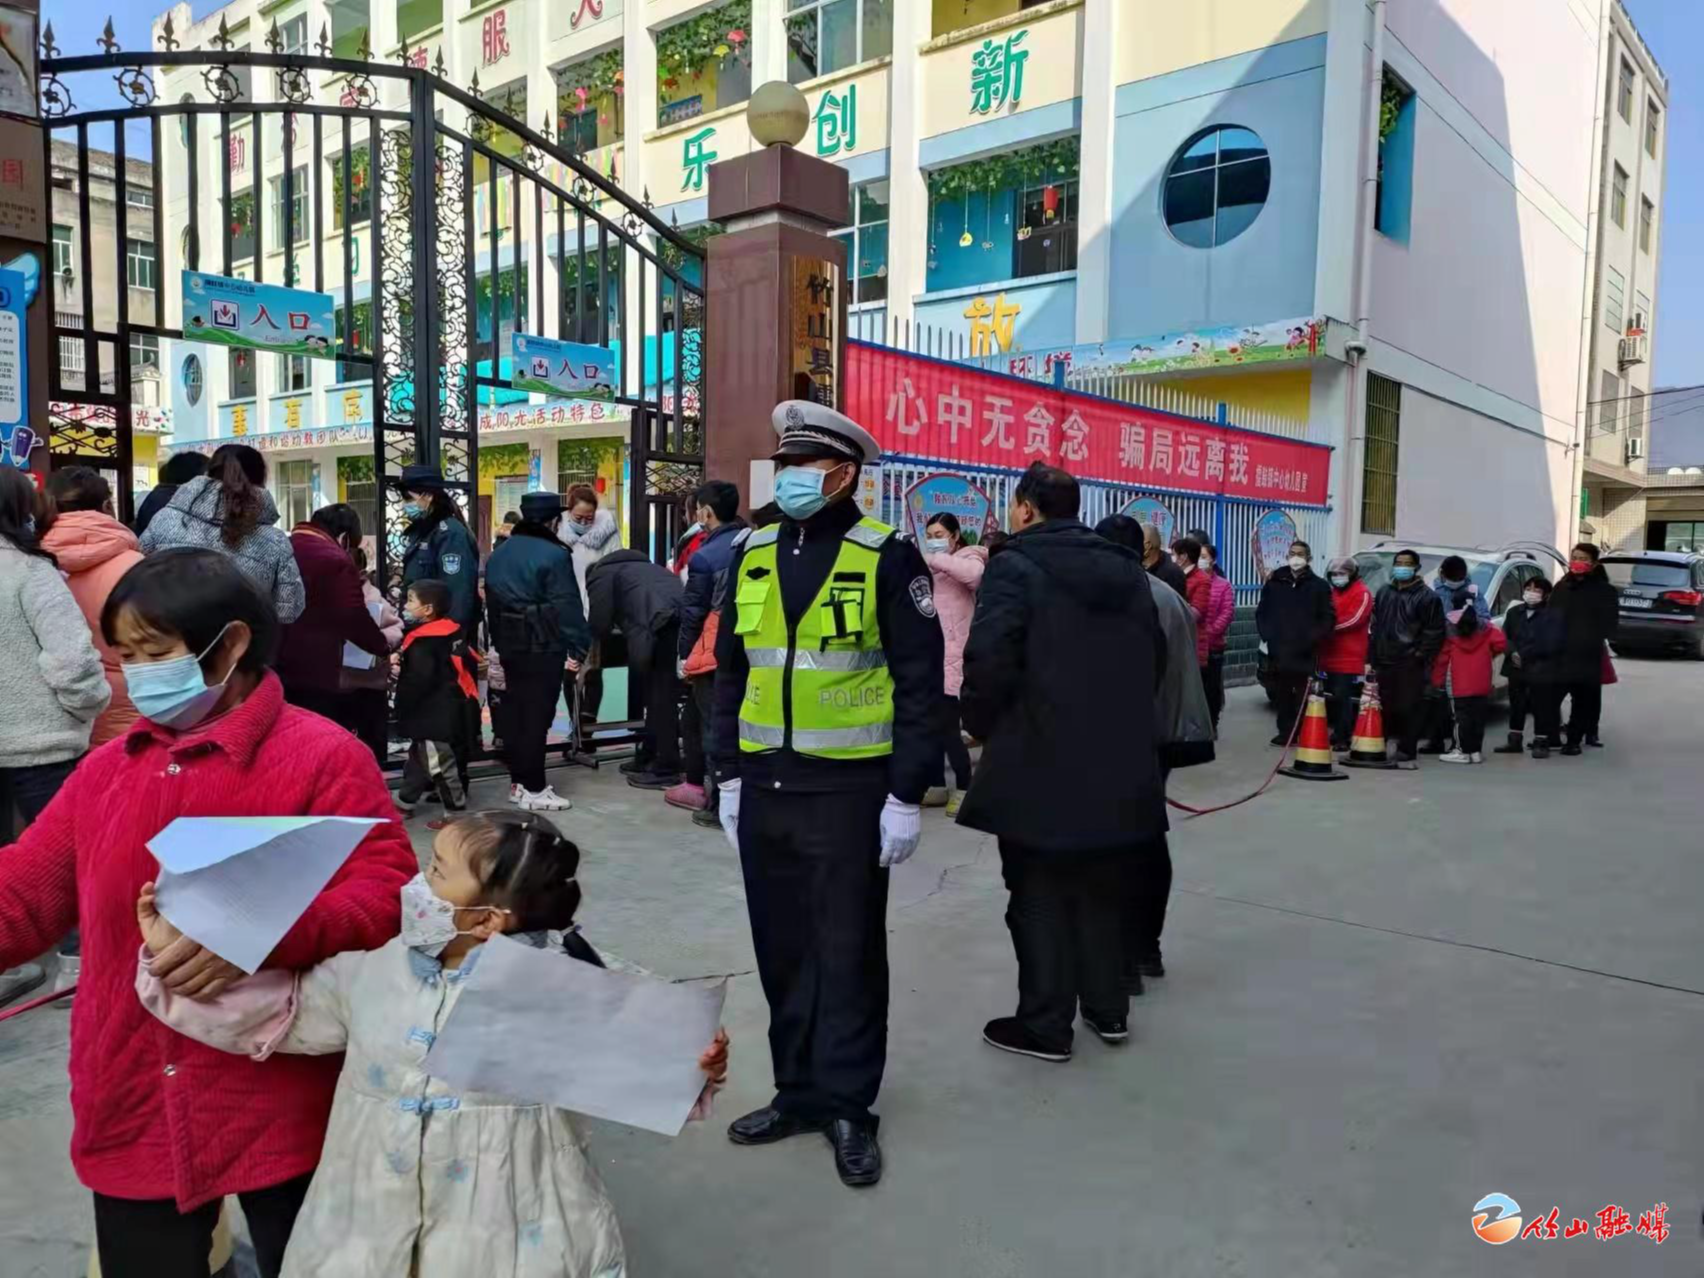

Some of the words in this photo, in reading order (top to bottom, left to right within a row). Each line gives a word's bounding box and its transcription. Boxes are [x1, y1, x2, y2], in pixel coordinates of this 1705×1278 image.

[482, 9, 510, 67] 服
[968, 30, 1030, 113] 新
[811, 84, 857, 157] 创
[681, 127, 719, 191] 乐
[250, 303, 311, 331] 入口
[963, 292, 1021, 357] 放
[557, 358, 600, 380] 入口
[885, 376, 1091, 462] 心中无贪念
[1118, 420, 1250, 486] 骗局远离我
[820, 686, 885, 708] POLICE
